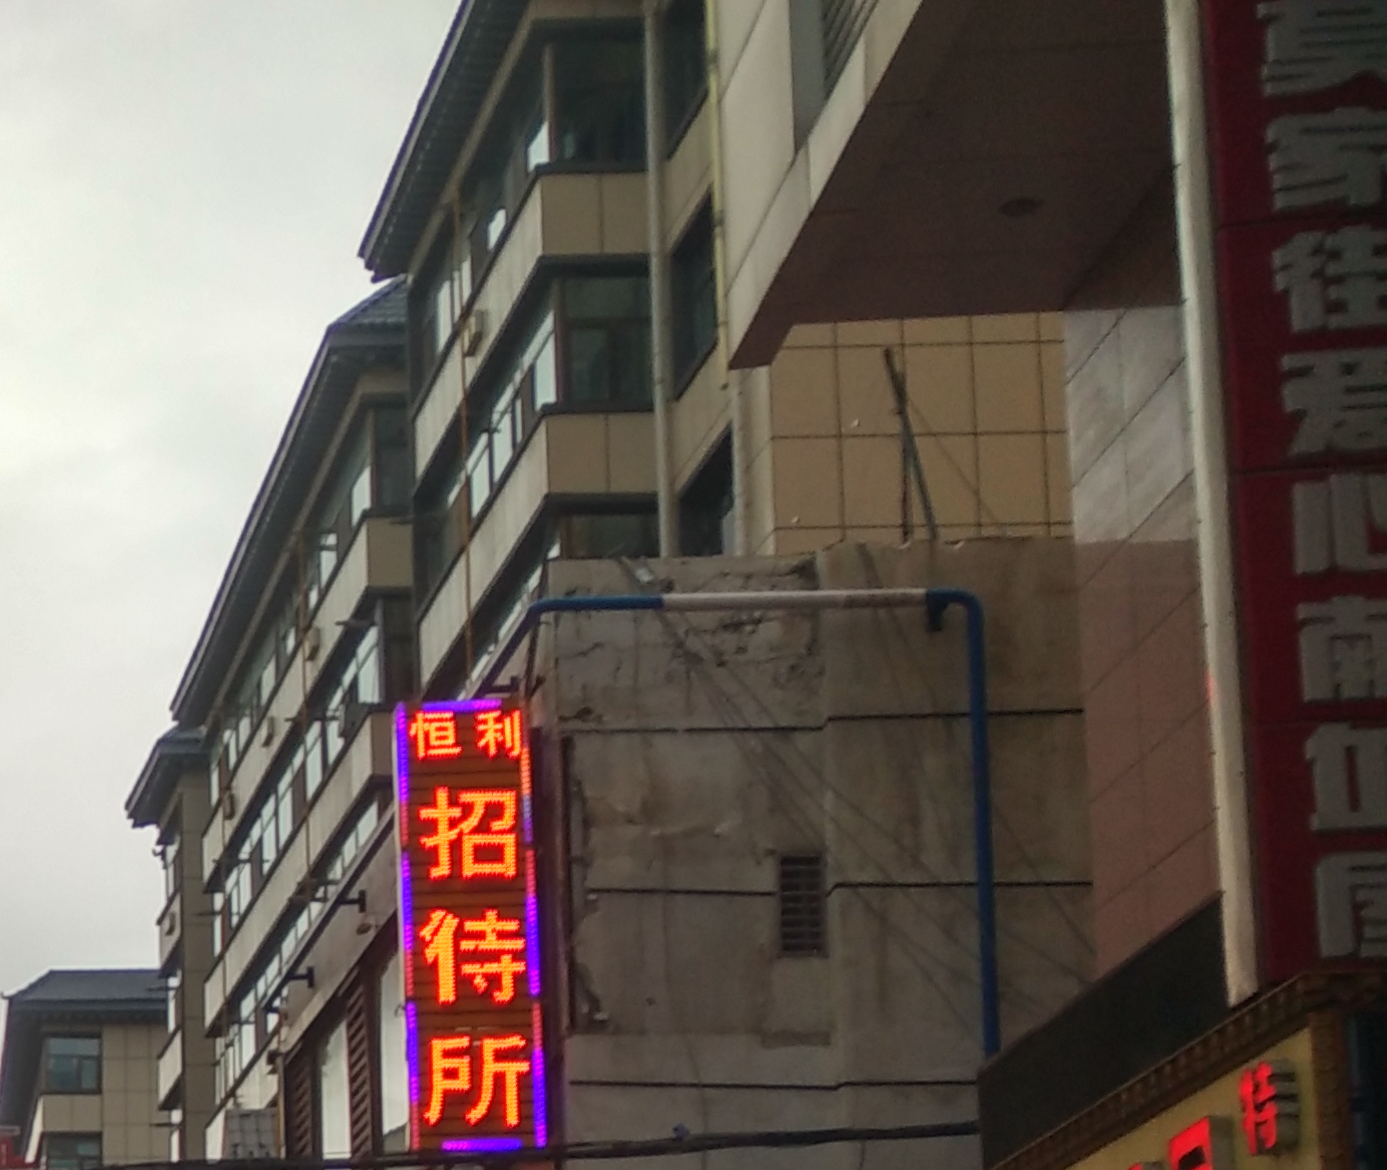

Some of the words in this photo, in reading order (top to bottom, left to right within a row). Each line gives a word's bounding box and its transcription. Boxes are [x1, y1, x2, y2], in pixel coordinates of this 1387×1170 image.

[409, 709, 523, 760] 恒利
[418, 785, 531, 1128] 招待所
